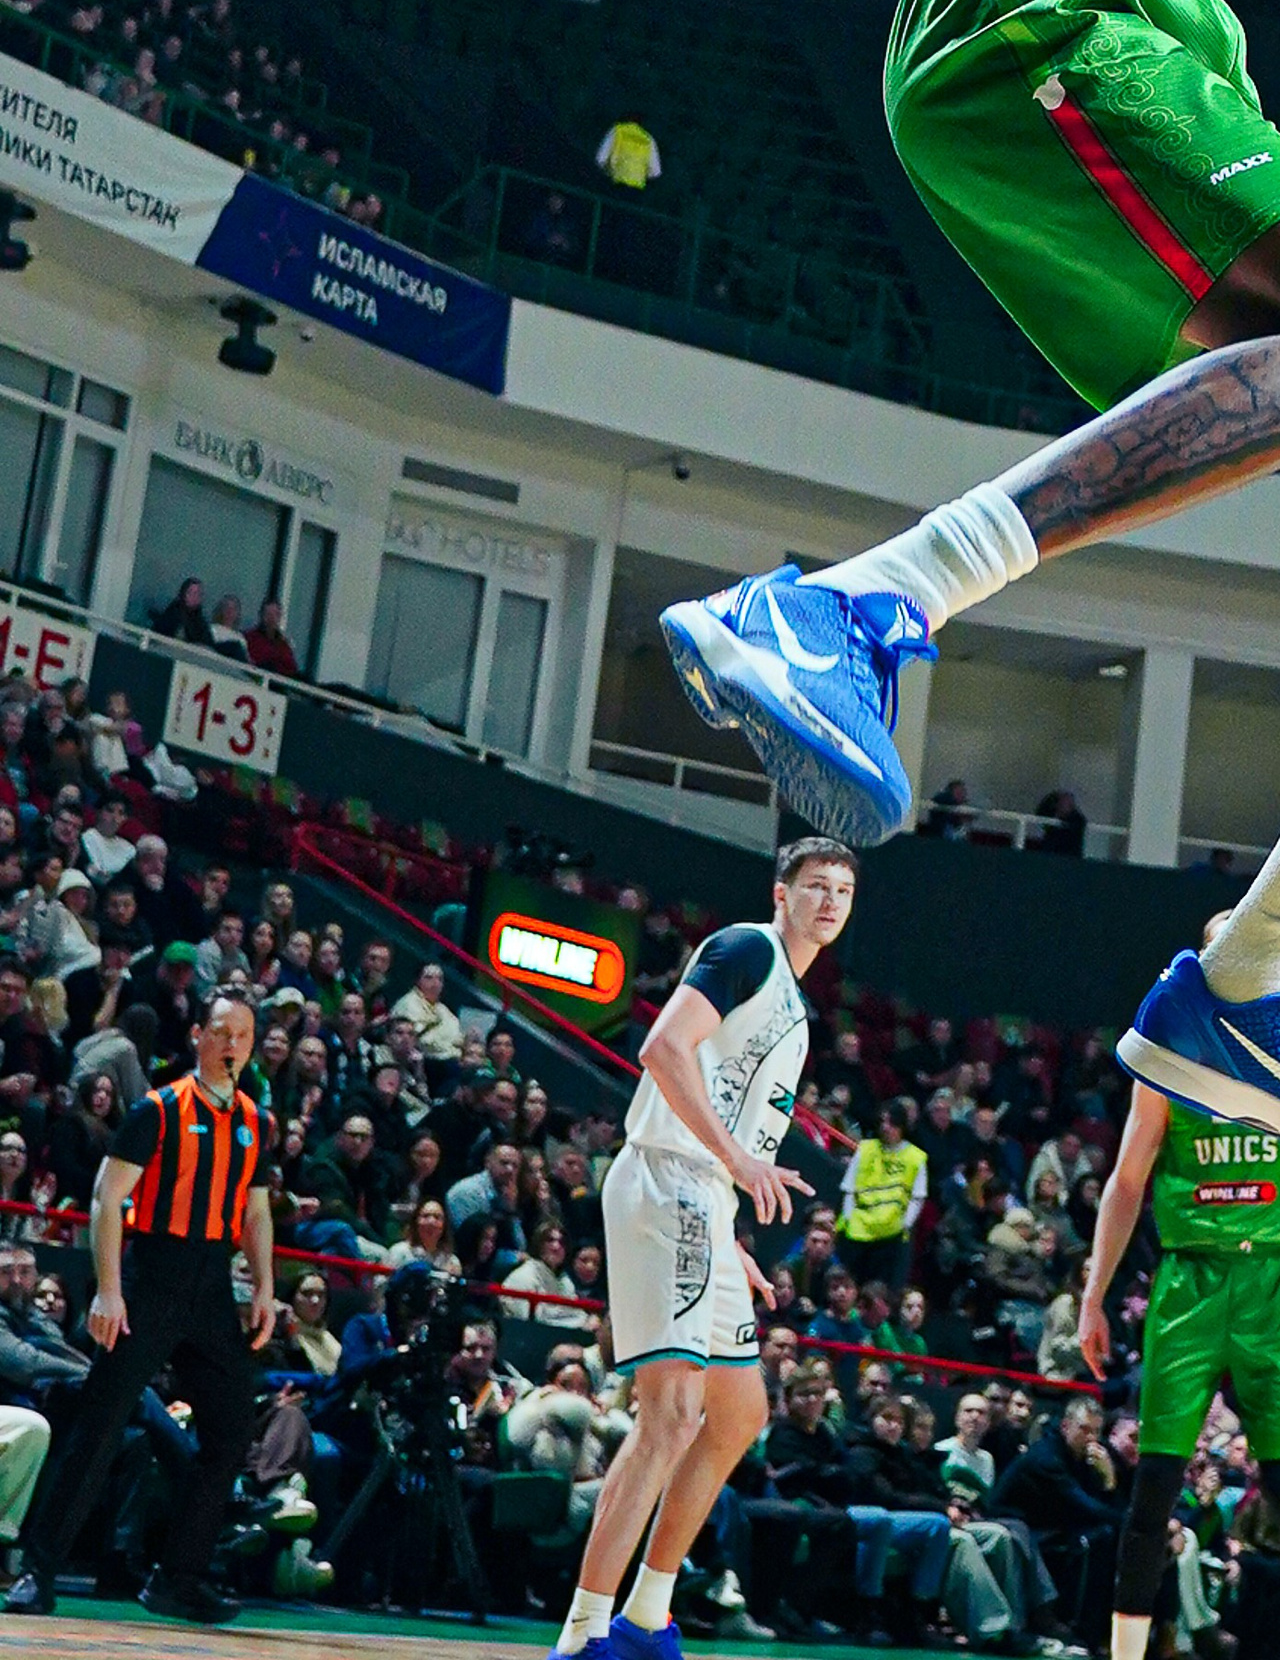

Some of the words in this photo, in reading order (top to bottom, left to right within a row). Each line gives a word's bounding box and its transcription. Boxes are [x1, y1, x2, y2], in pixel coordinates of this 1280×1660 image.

[0, 83, 79, 144] ИТЕЛЯ
[59, 154, 181, 232] ТАТАРСТАН
[1210, 150, 1273, 185] MAXX
[311, 274, 379, 327] КАРТА
[317, 232, 448, 316] ИСЛАМСКАЯ
[499, 925, 599, 986] WINLINE
[1194, 1135, 1279, 1166] UNICS
[1198, 1185, 1260, 1201] WINLINE
